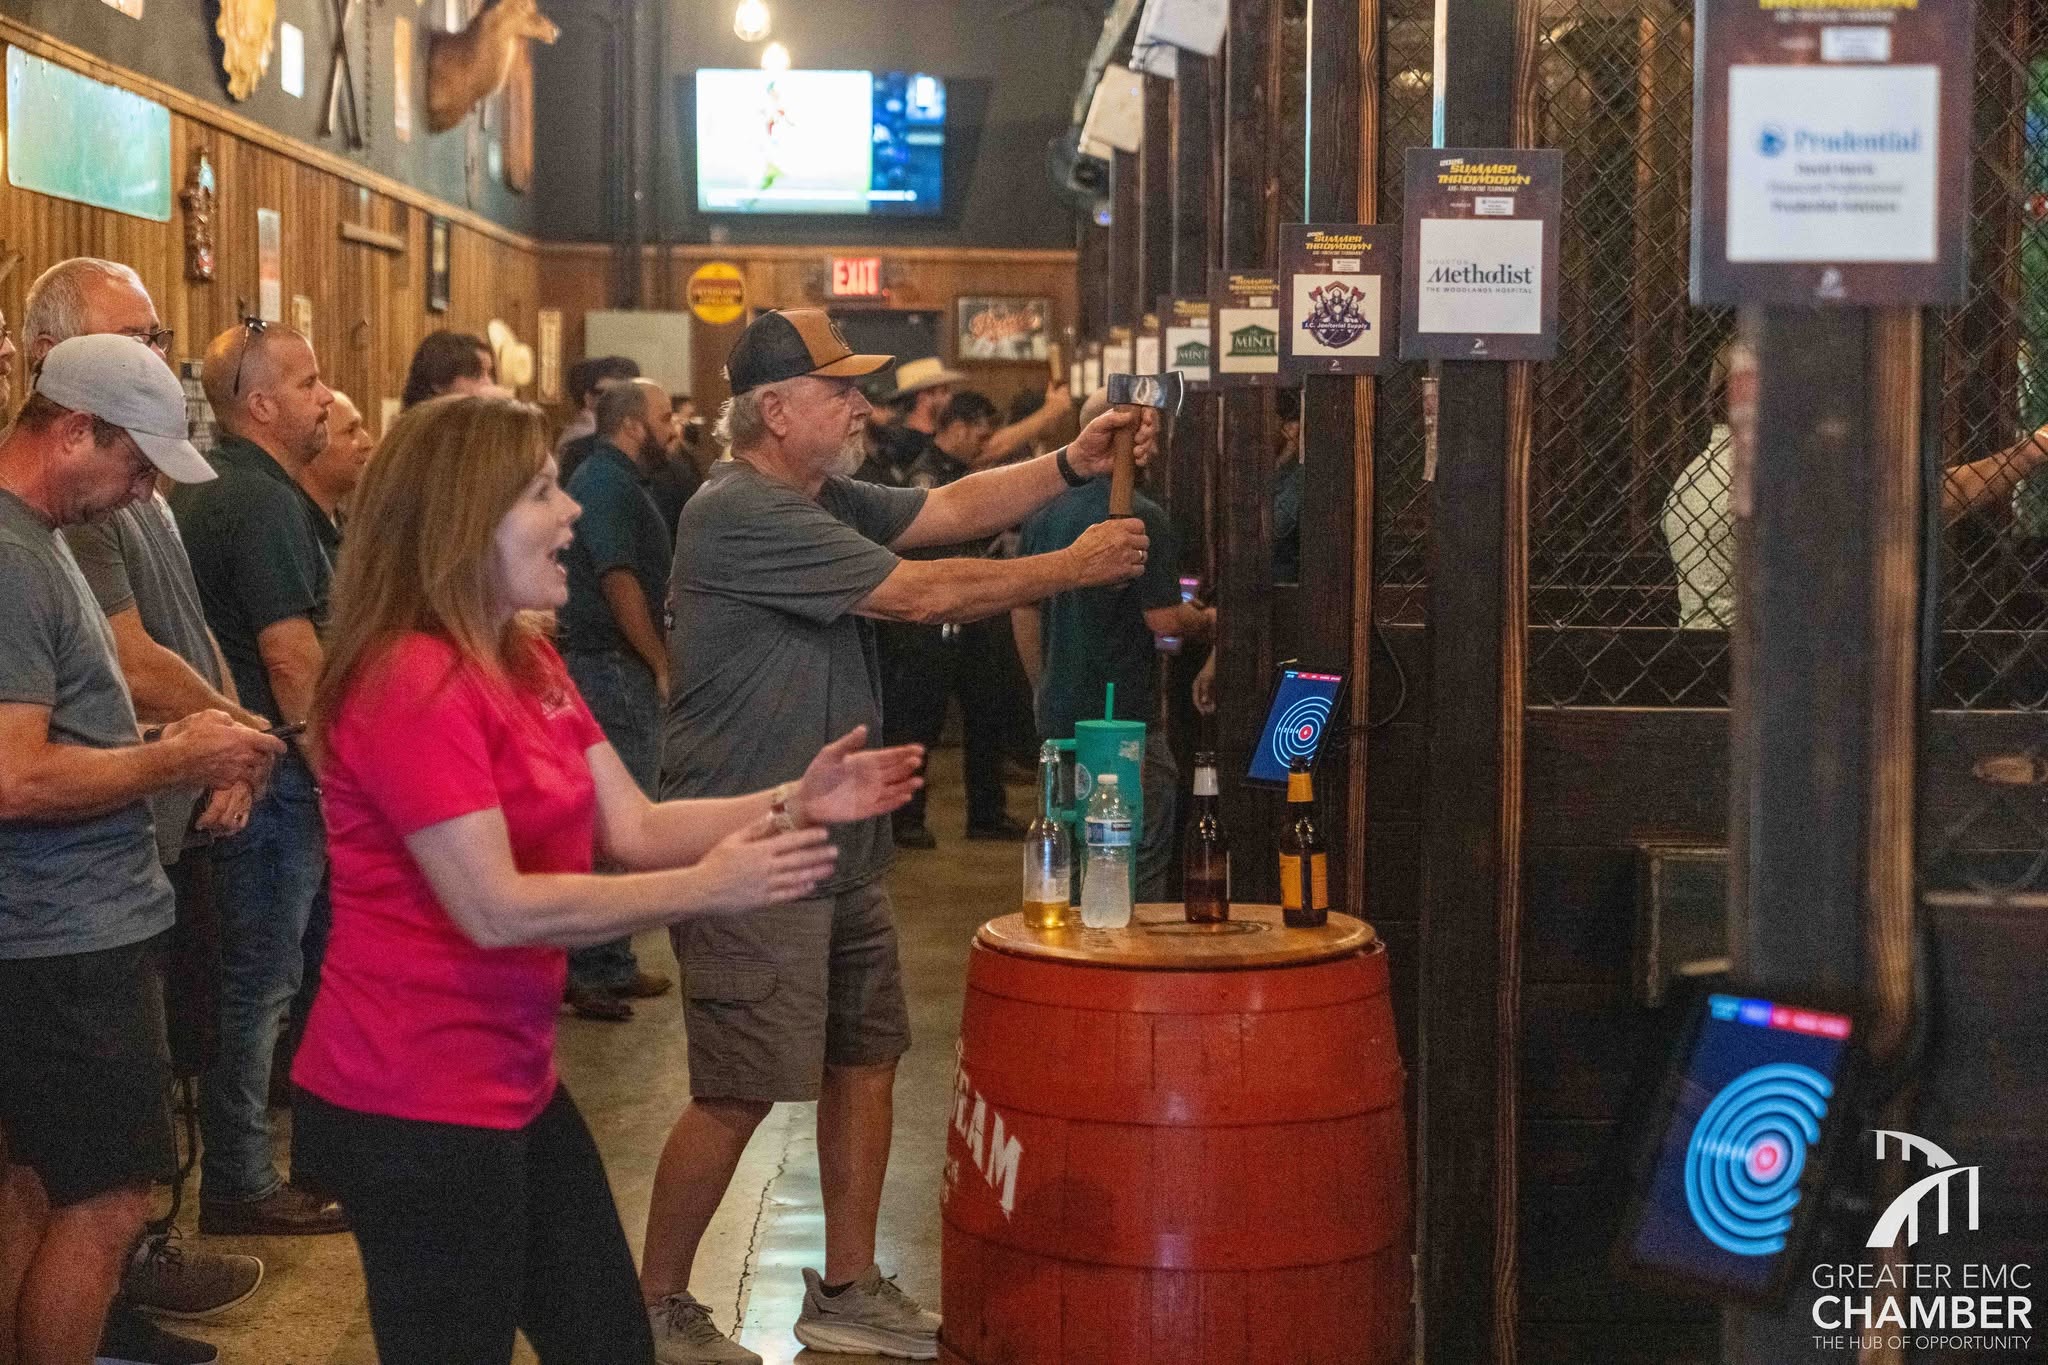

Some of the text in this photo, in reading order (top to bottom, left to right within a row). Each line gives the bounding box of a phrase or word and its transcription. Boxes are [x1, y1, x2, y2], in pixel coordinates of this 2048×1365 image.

[1794, 129, 1919, 152] Prudential
[1437, 174, 1531, 185] THROWDOWN
[833, 259, 878, 295] EXIT
[1427, 263, 1532, 284] Methodist
[1346, 322, 1367, 330] Supply
[1235, 335, 1273, 347] MINT
